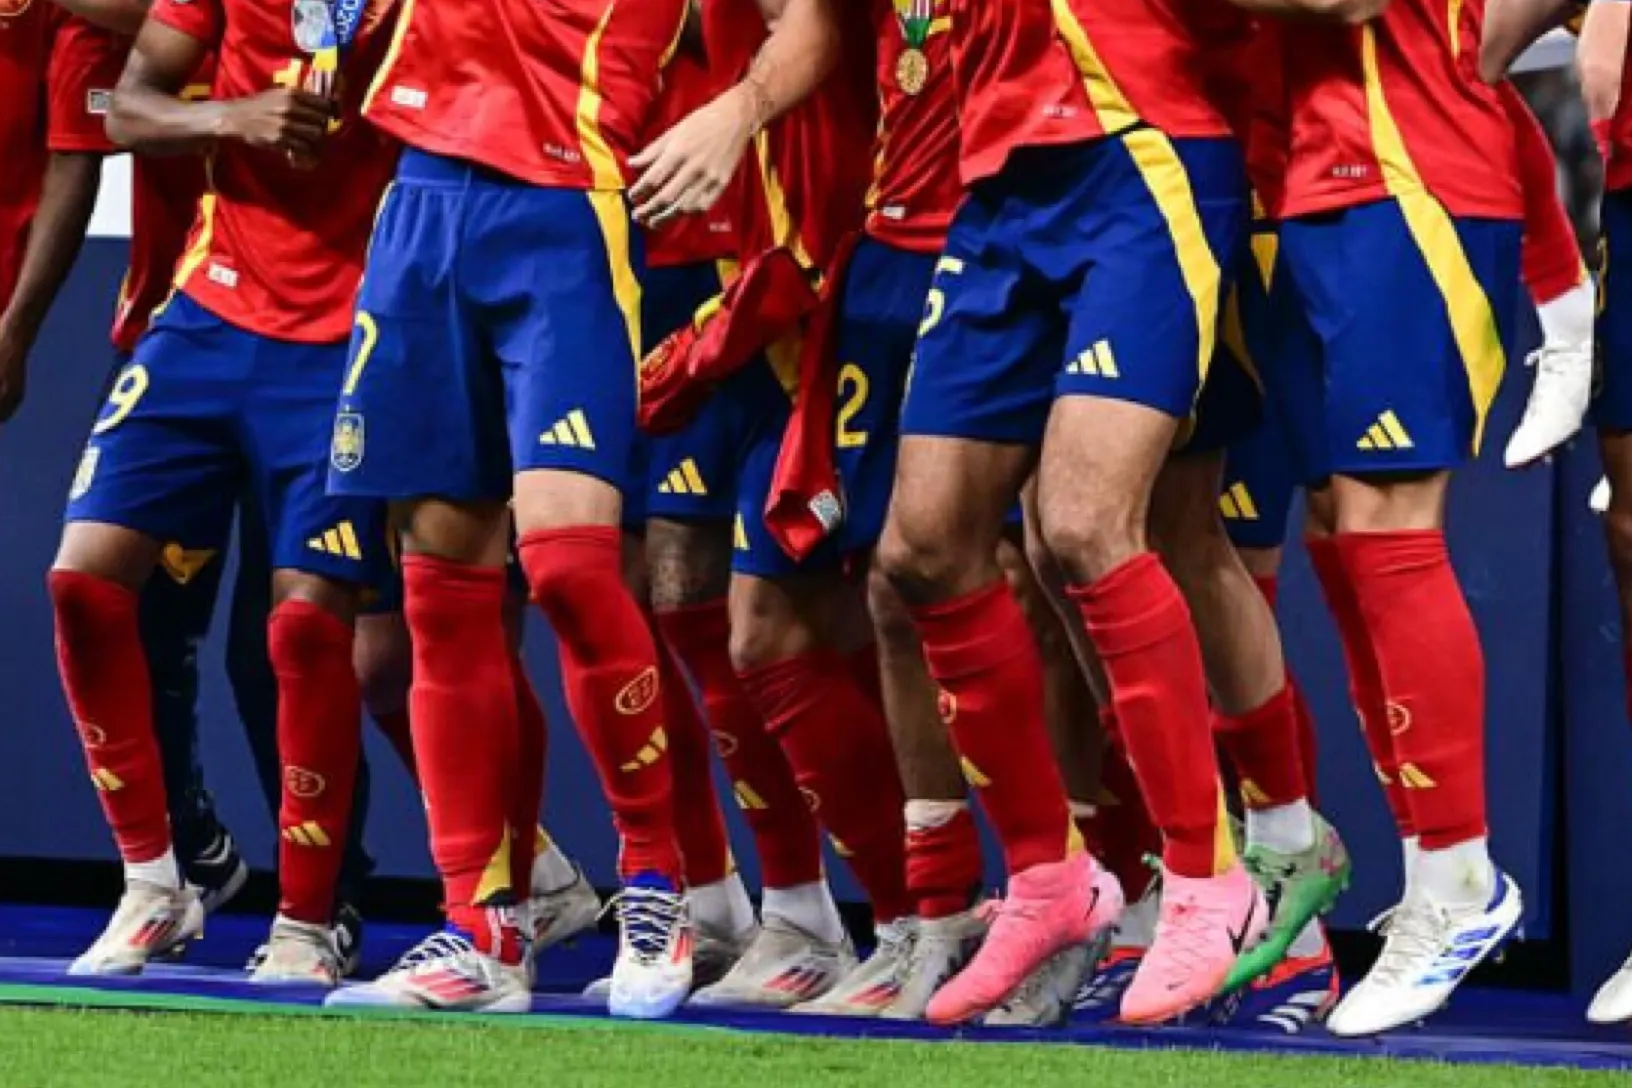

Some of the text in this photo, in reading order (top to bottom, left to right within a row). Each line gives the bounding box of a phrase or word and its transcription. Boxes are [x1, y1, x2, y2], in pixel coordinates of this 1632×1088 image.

[343, 311, 378, 396] 7
[93, 365, 149, 435] 9
[836, 364, 869, 448] 2
